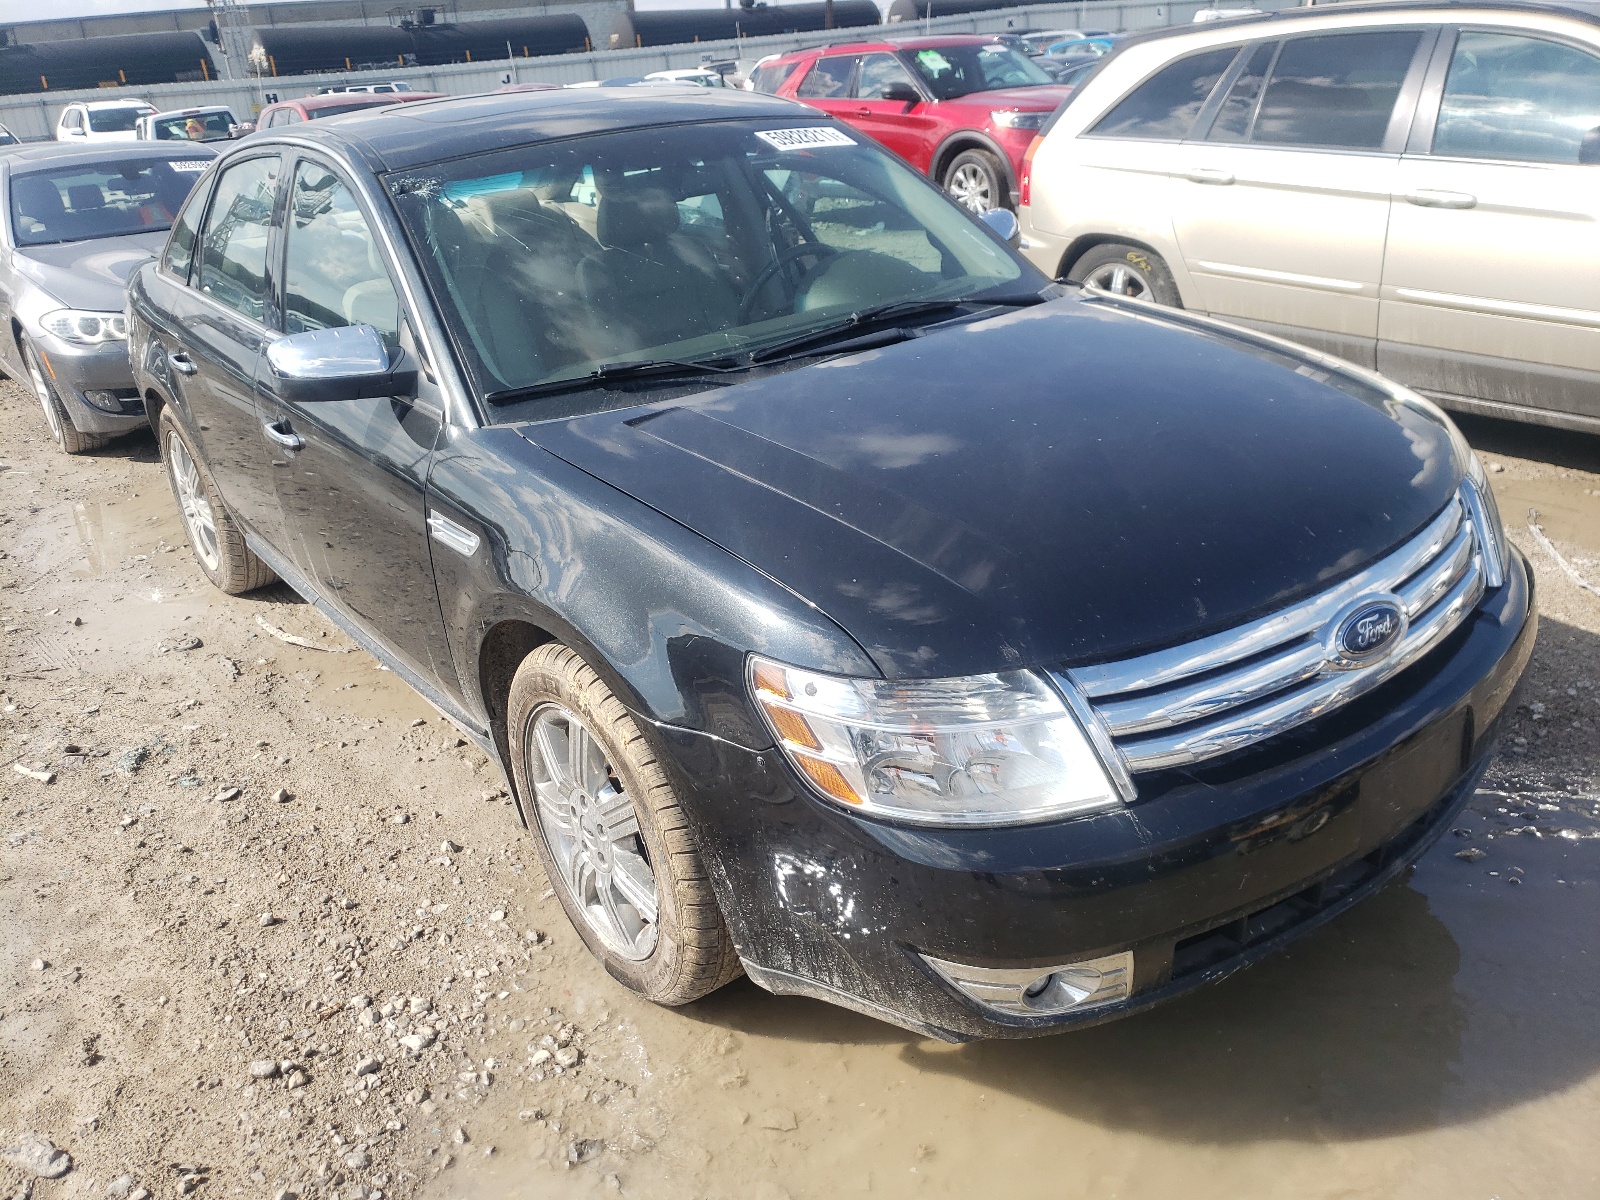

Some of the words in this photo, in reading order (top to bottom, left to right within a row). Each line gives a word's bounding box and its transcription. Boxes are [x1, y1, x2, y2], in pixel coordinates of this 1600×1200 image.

[1007, 19, 1014, 28] K
[501, 74, 511, 85] J
[265, 93, 279, 104] H
[1357, 613, 1393, 648] Ford
